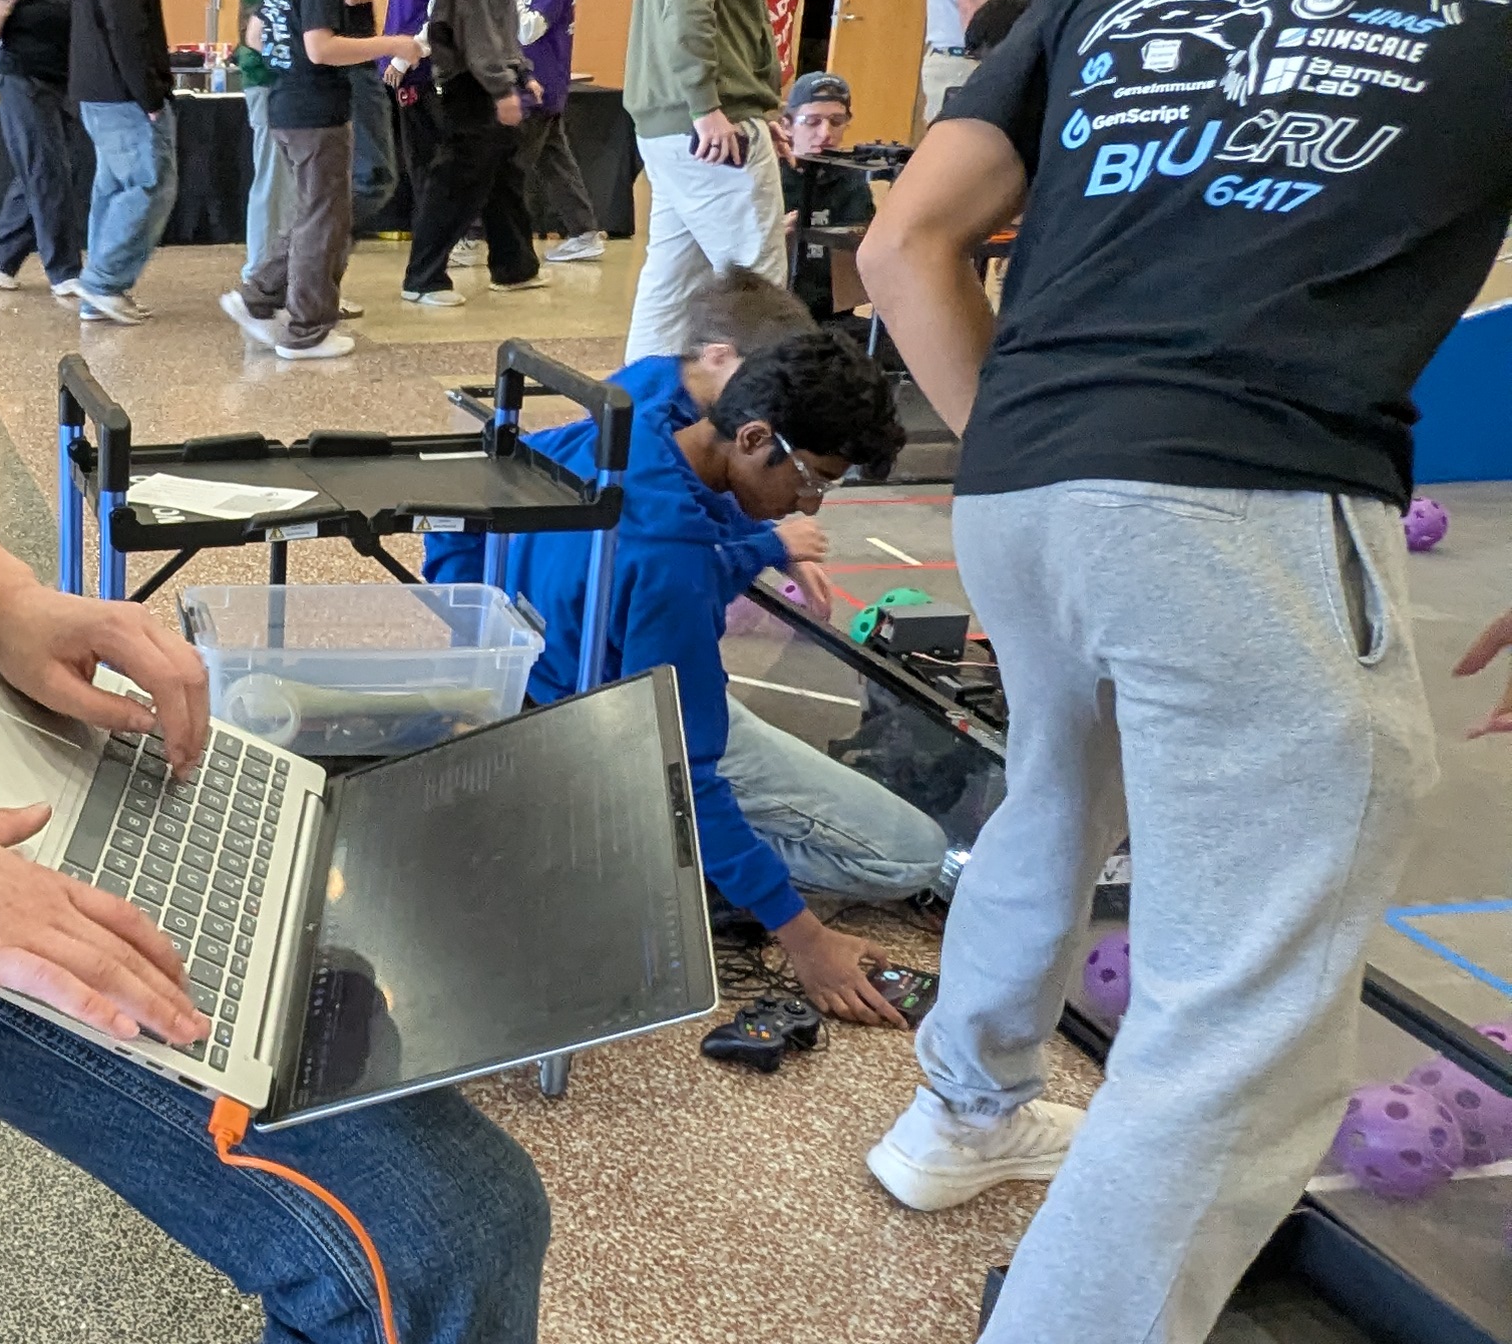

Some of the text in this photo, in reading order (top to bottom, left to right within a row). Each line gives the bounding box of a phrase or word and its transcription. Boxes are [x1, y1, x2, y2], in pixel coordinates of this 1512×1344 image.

[1307, 27, 1430, 63] SIMSCALE
[1297, 74, 1362, 97] Lab
[1306, 57, 1430, 93] Bambu
[1092, 106, 1190, 130] GenScript
[1202, 174, 1326, 212] 6417
